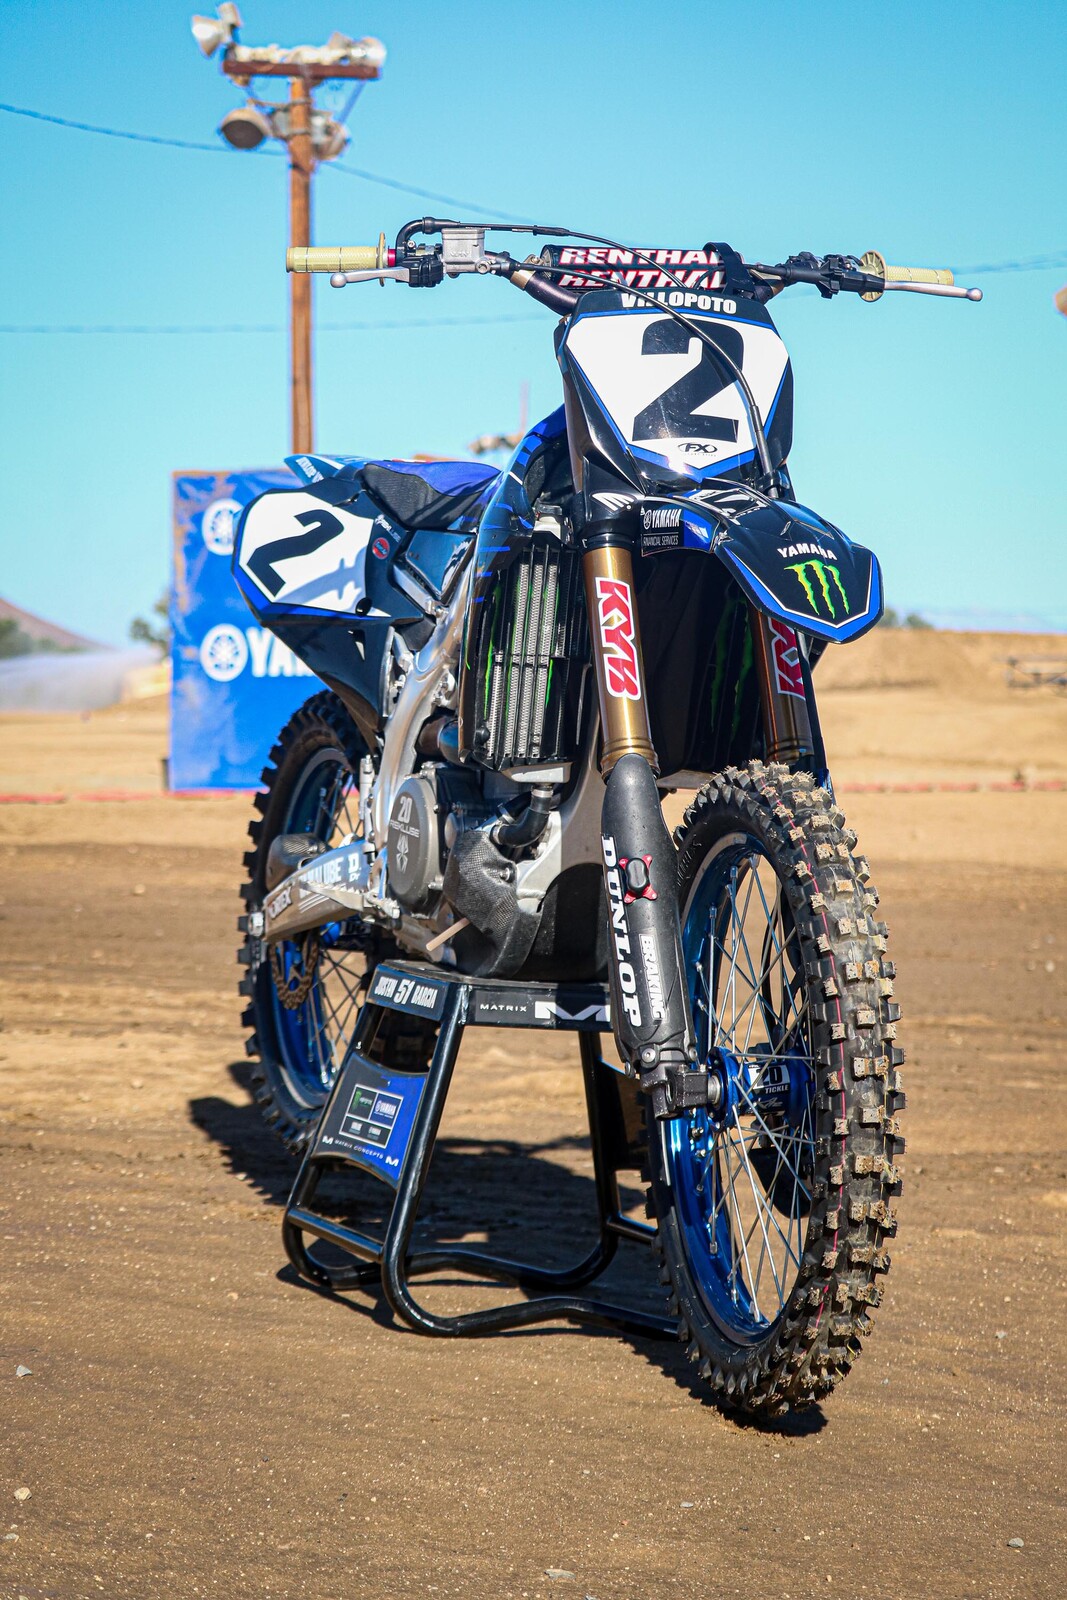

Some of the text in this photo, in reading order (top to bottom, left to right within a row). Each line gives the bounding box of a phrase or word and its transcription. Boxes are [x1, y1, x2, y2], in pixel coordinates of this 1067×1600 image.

[621, 291, 737, 315] VILLOPOTO
[632, 318, 744, 442] 2
[652, 509, 682, 528] YAMAHA
[643, 535, 679, 546] FINANCIAL SERVICES
[777, 542, 838, 561] YAMAHA
[246, 509, 345, 598] 2
[595, 577, 641, 701] KYB
[398, 796, 412, 823] 20
[602, 836, 642, 1027] DUNLOP
[641, 935, 666, 1019] BRAKING
[394, 978, 416, 1005] 51
[480, 1003, 527, 1012] MATRIX
[755, 1066, 783, 1087] 20
[765, 1084, 789, 1094] TICKLE
[334, 1139, 352, 1149] MATRIX
[353, 1145, 384, 1160] CONCEPTS
